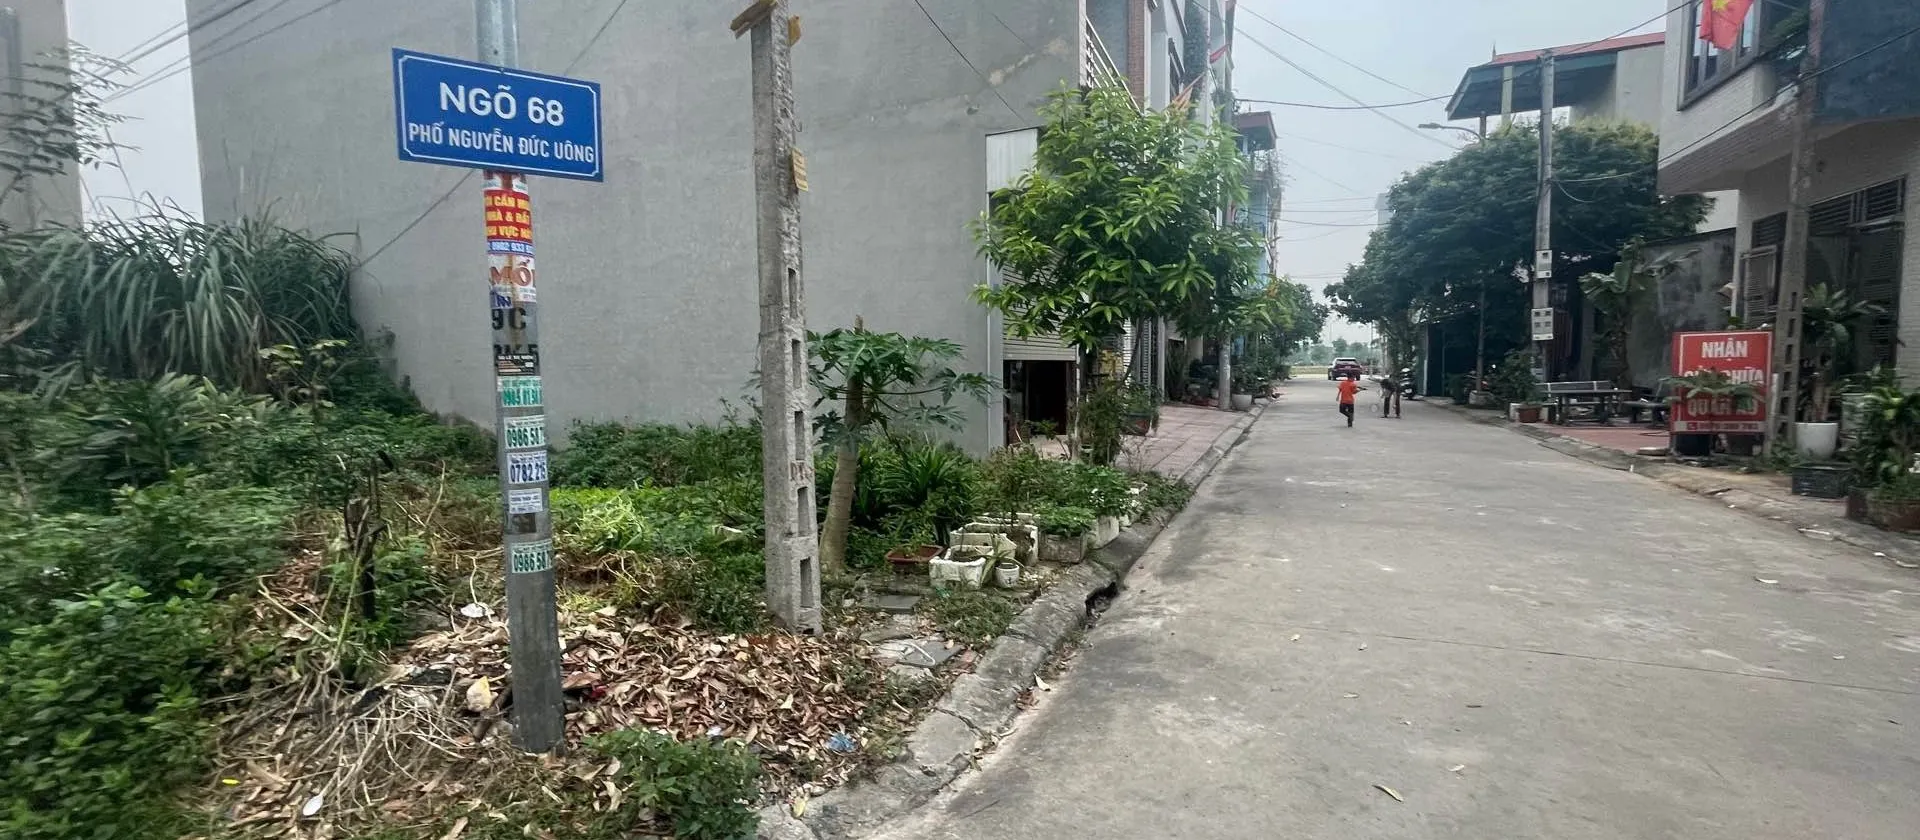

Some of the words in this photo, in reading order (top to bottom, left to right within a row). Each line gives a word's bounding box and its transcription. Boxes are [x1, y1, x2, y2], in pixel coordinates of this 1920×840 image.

[439, 82, 517, 120] NGÕ
[527, 97, 565, 127] 68
[408, 121, 445, 145] PHỐ
[448, 128, 514, 154] NGUYỄN
[517, 135, 550, 158] ĐỨC
[554, 140, 594, 163] UÔNG
[1701, 338, 1748, 361] NHẬN
